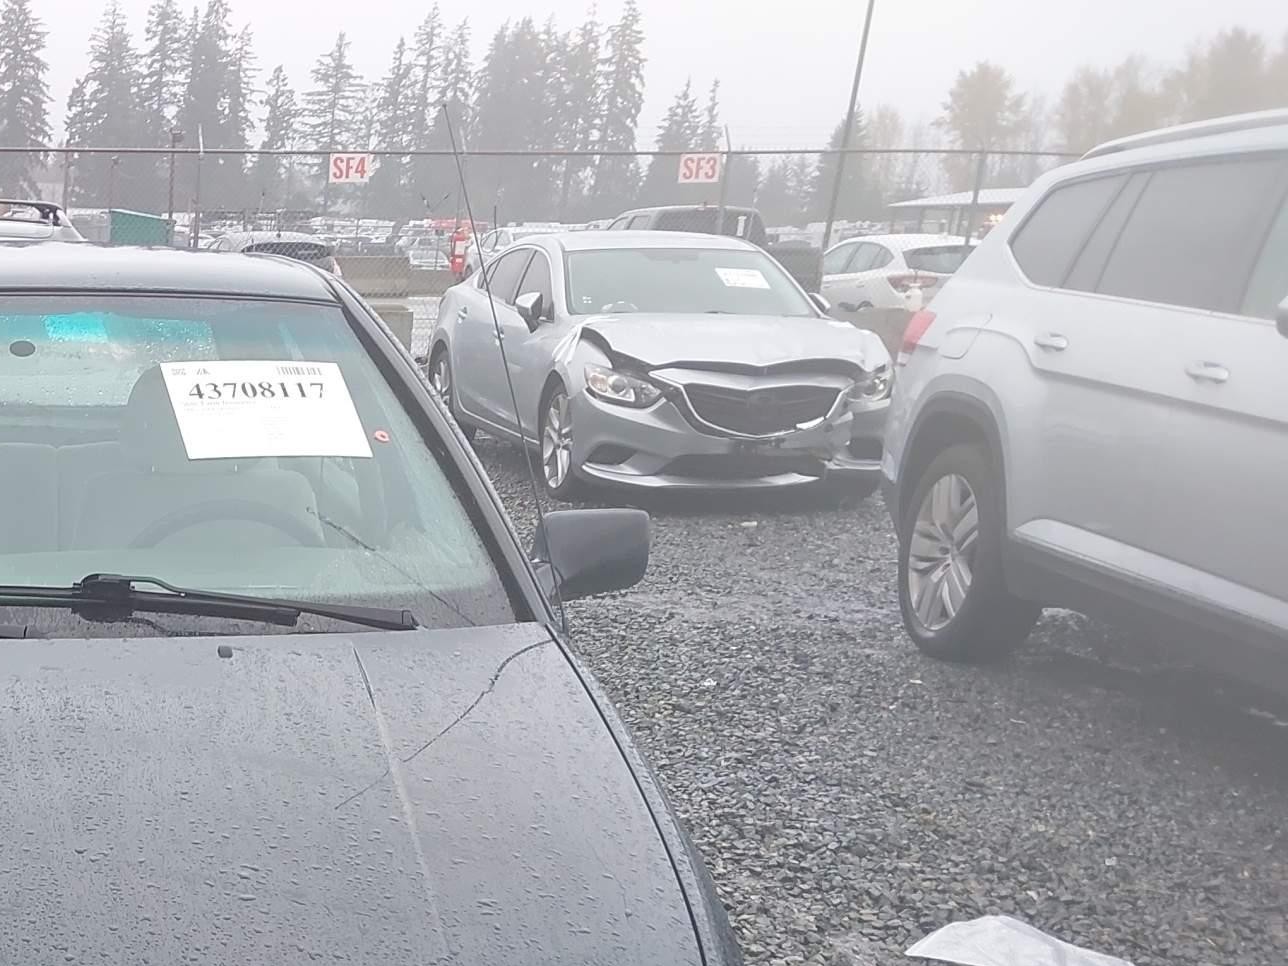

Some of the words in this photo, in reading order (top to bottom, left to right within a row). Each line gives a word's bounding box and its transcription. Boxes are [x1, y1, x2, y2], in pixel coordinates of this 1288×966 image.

[332, 156, 367, 180] SF4
[682, 156, 720, 181] SF3
[188, 380, 324, 400] 43708117
